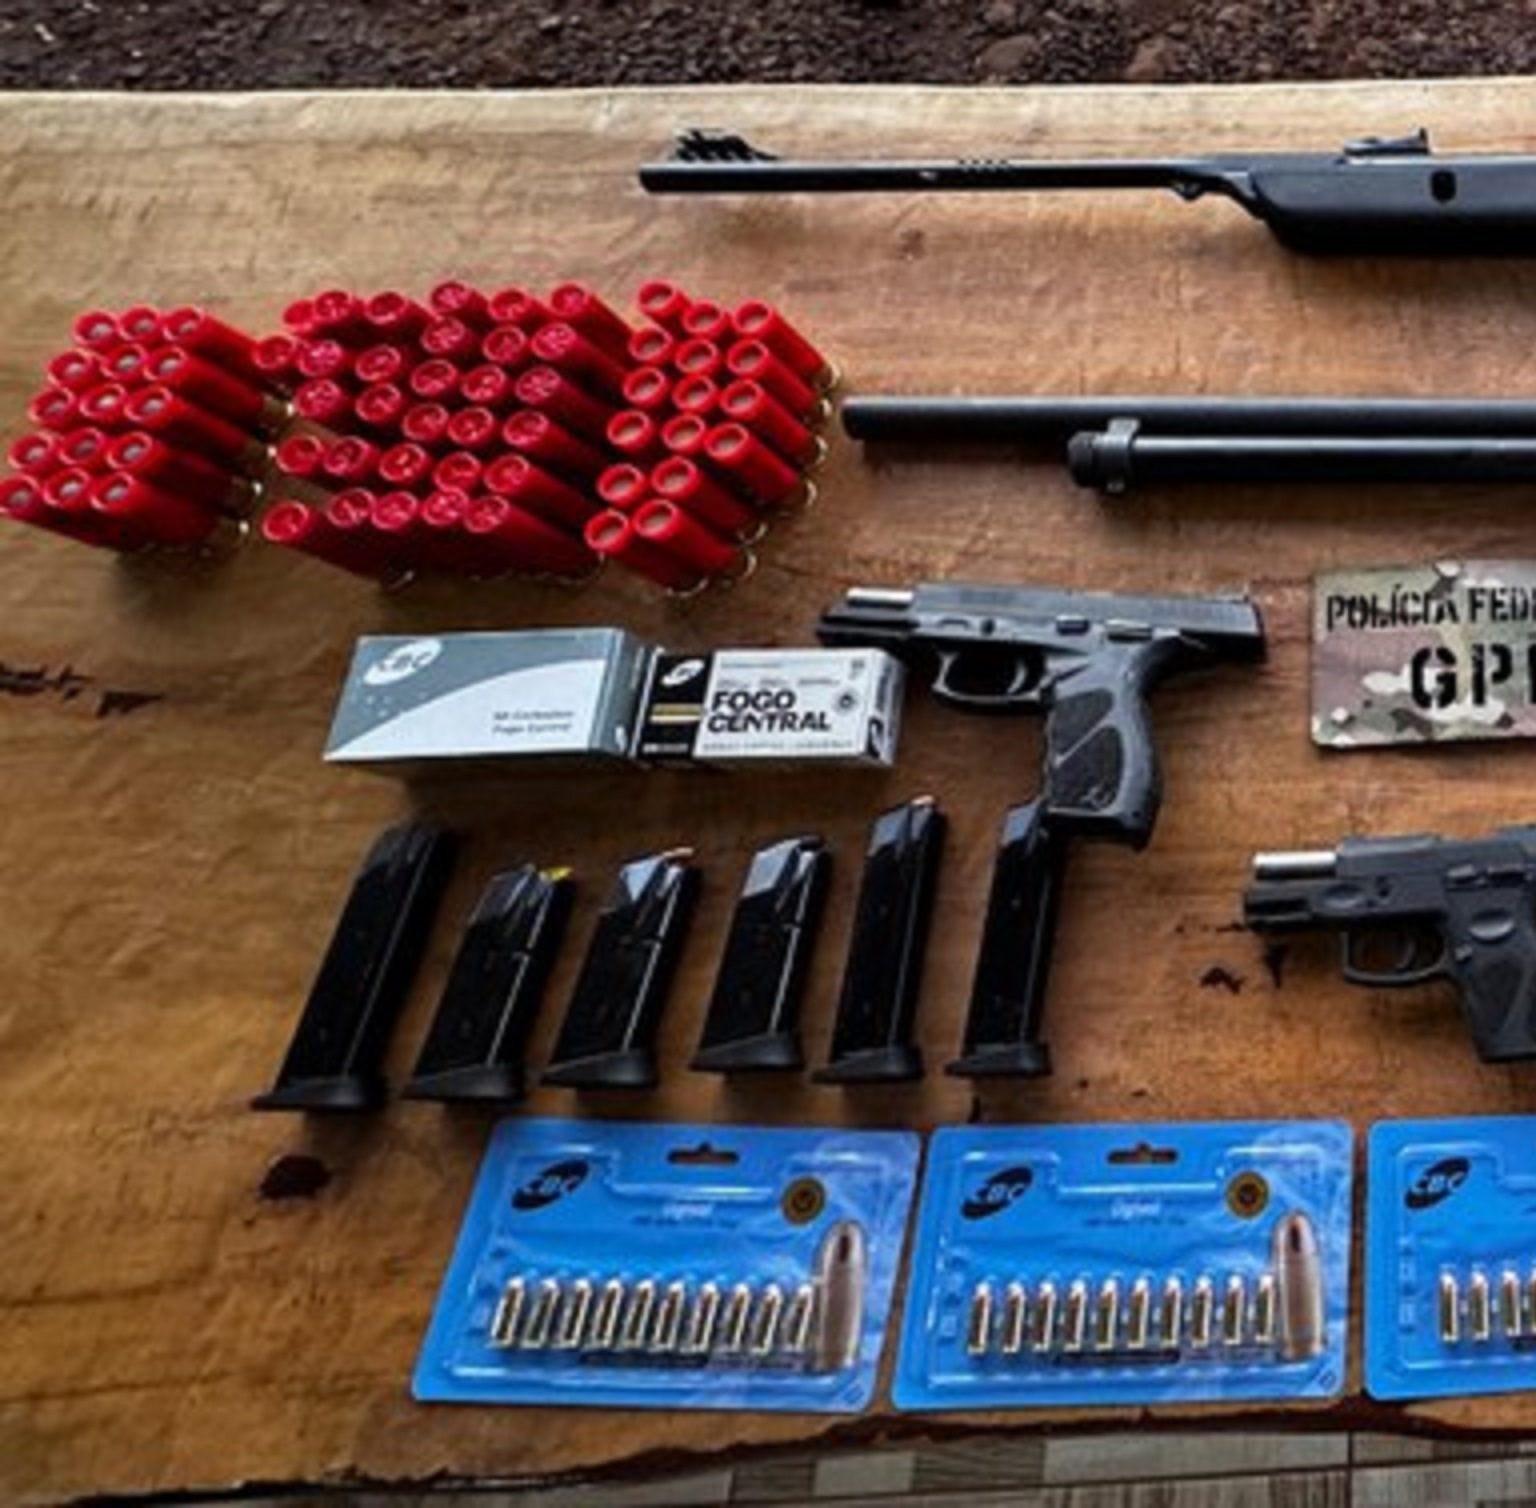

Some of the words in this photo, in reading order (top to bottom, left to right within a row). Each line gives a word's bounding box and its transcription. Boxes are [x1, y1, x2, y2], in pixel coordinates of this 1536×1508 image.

[1327, 583, 1460, 632] POLÍCIA
[711, 690, 796, 714] FOGO
[707, 711, 832, 733] CENTRAL
